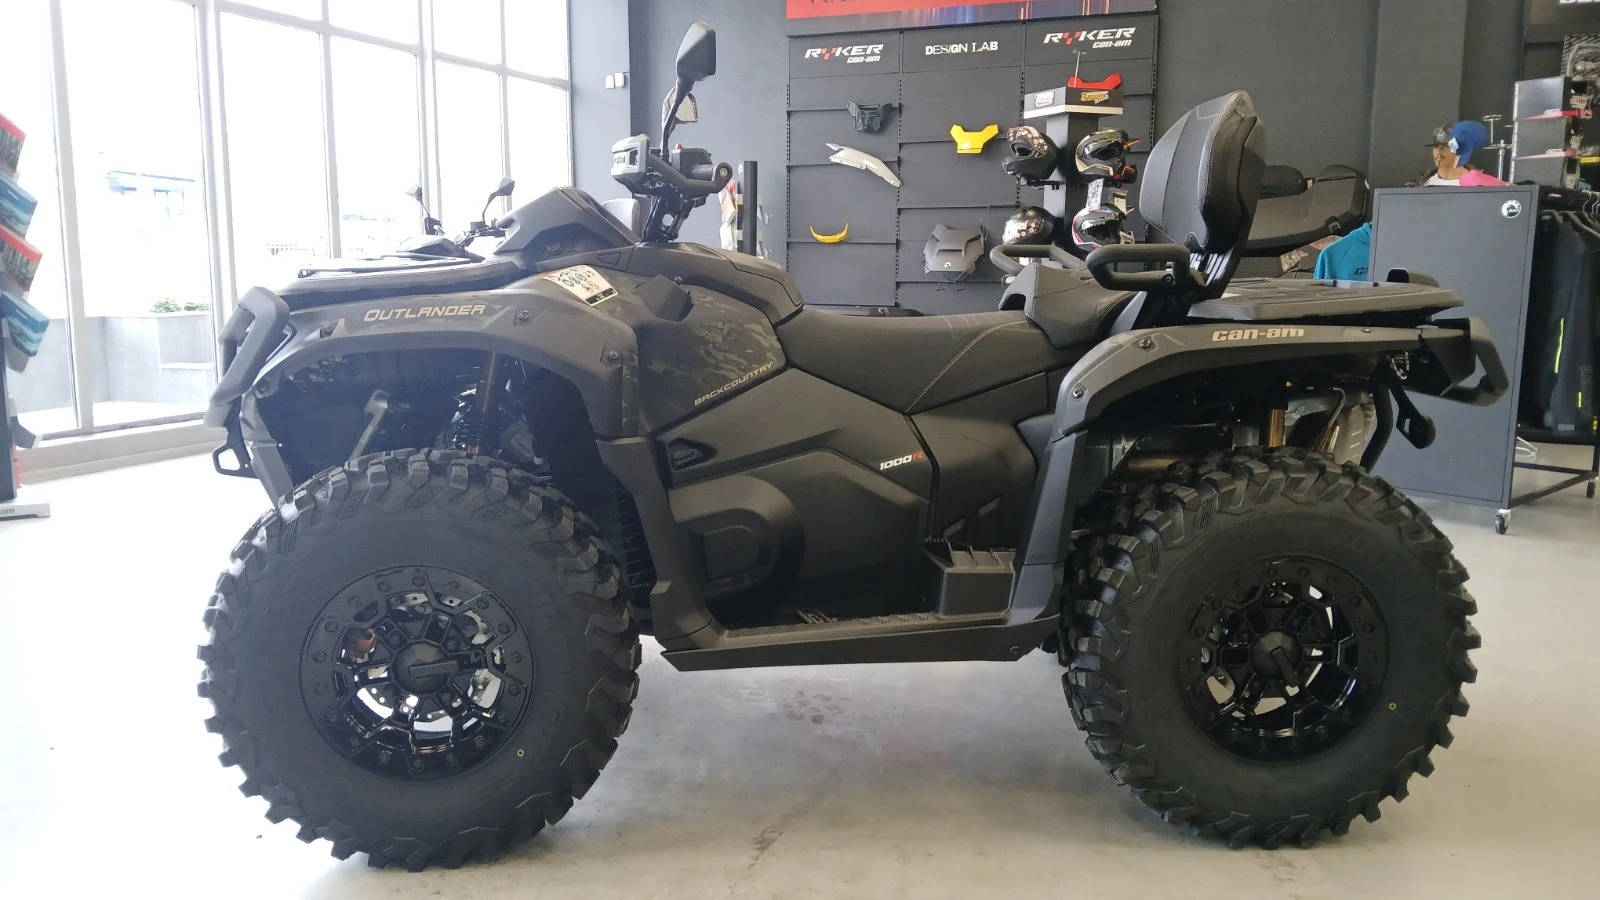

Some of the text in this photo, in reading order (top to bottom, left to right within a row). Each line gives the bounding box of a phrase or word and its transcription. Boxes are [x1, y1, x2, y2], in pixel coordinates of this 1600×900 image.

[1043, 28, 1136, 45] RYKER
[1092, 40, 1132, 49] can-am
[804, 44, 884, 60] RYKER
[925, 41, 998, 56] DESIGN LAB
[846, 55, 881, 64] can-am
[363, 304, 486, 322] OUTLANDER
[1212, 327, 1304, 342] can-am
[694, 361, 773, 406] BACKCOUNTRY
[879, 451, 924, 471] 1000R
